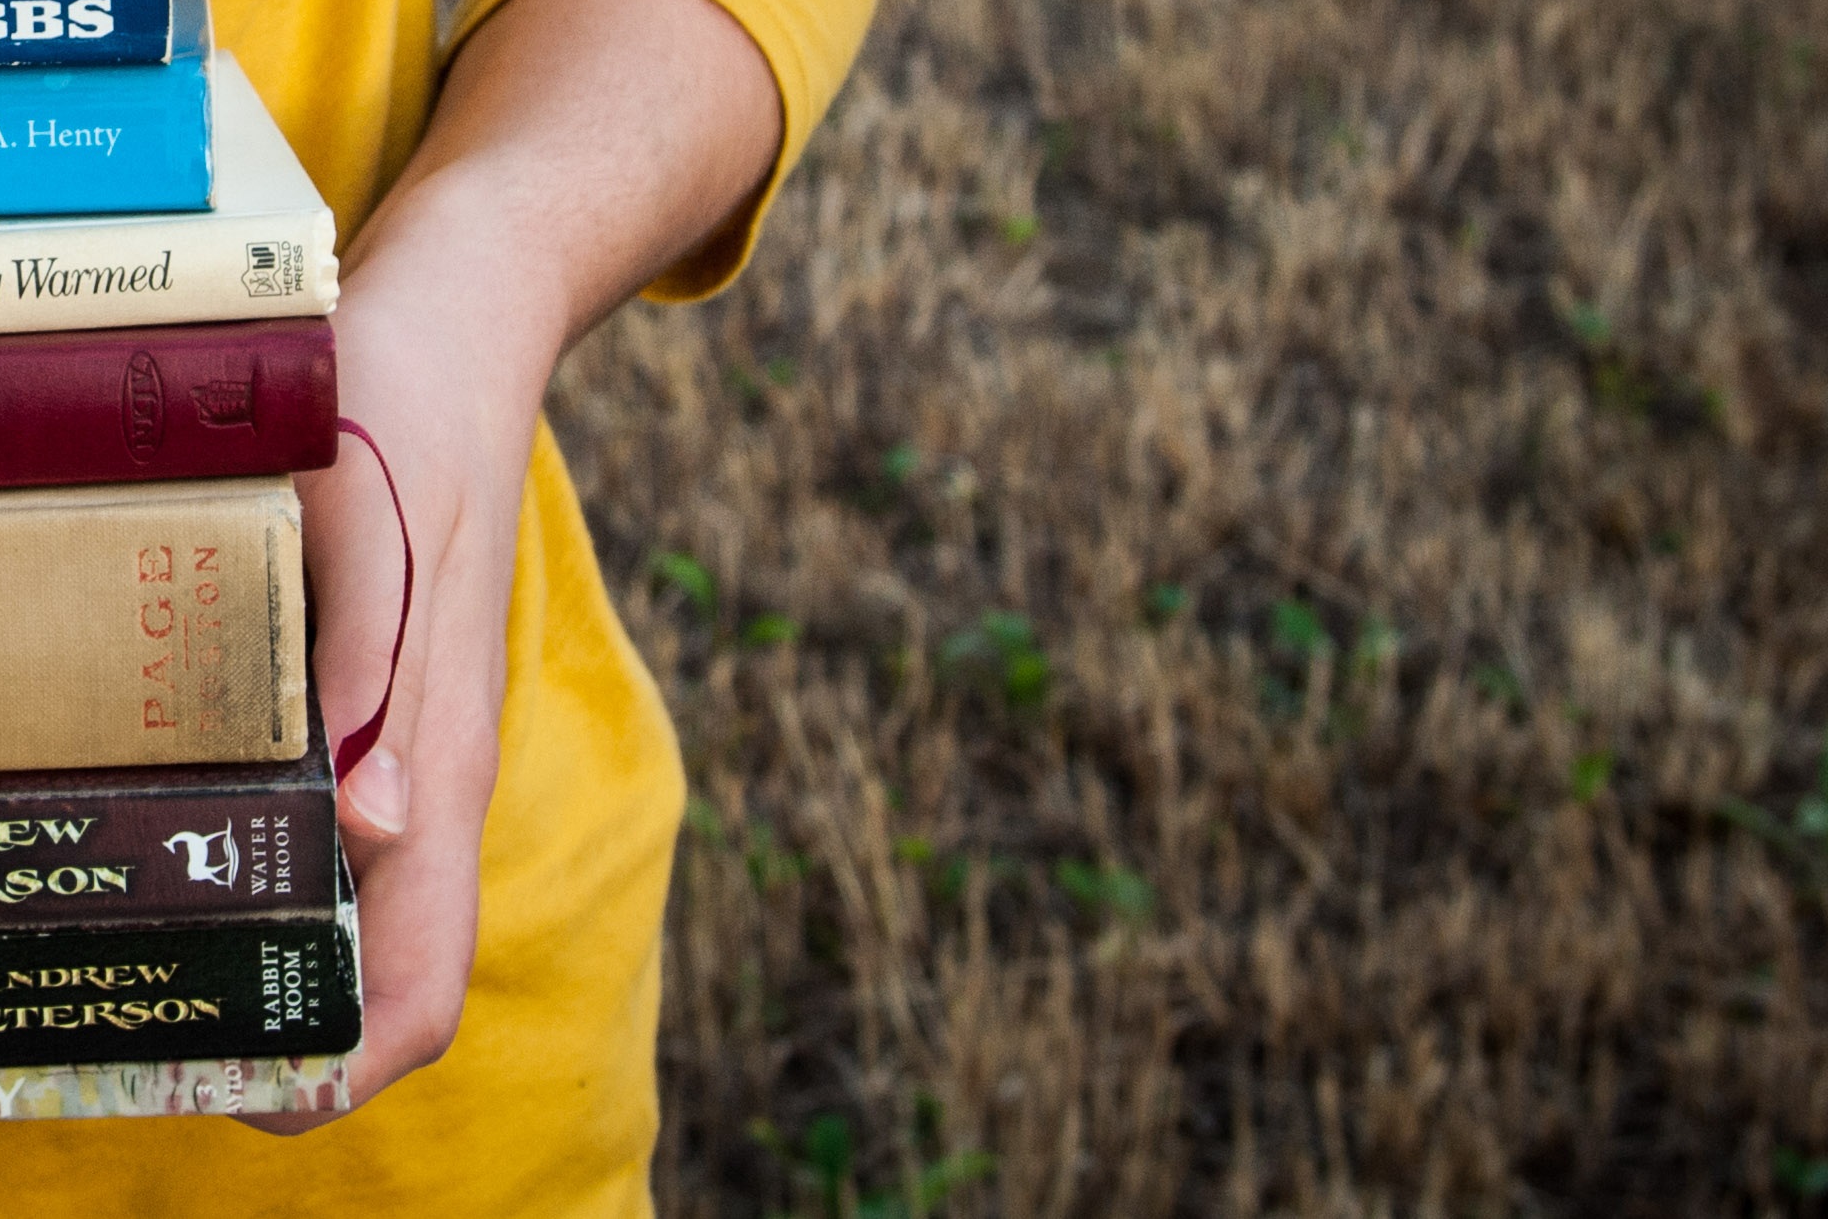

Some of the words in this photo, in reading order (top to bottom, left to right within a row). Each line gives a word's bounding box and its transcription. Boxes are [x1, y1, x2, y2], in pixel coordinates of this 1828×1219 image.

[27, 118, 122, 156] Henty
[10, 250, 173, 298] Warmed
[281, 240, 293, 296] HERALD
[293, 244, 304, 291] PRESS
[138, 545, 177, 730] PAGE
[194, 547, 222, 732] BOSTON
[251, 814, 268, 895] WATER
[273, 814, 292, 894] BROOK
[261, 941, 281, 1031] RABBIT
[283, 949, 303, 1021] ROOM
[306, 941, 320, 1027] PRESS
[224, 1059, 244, 1115] AYLO
